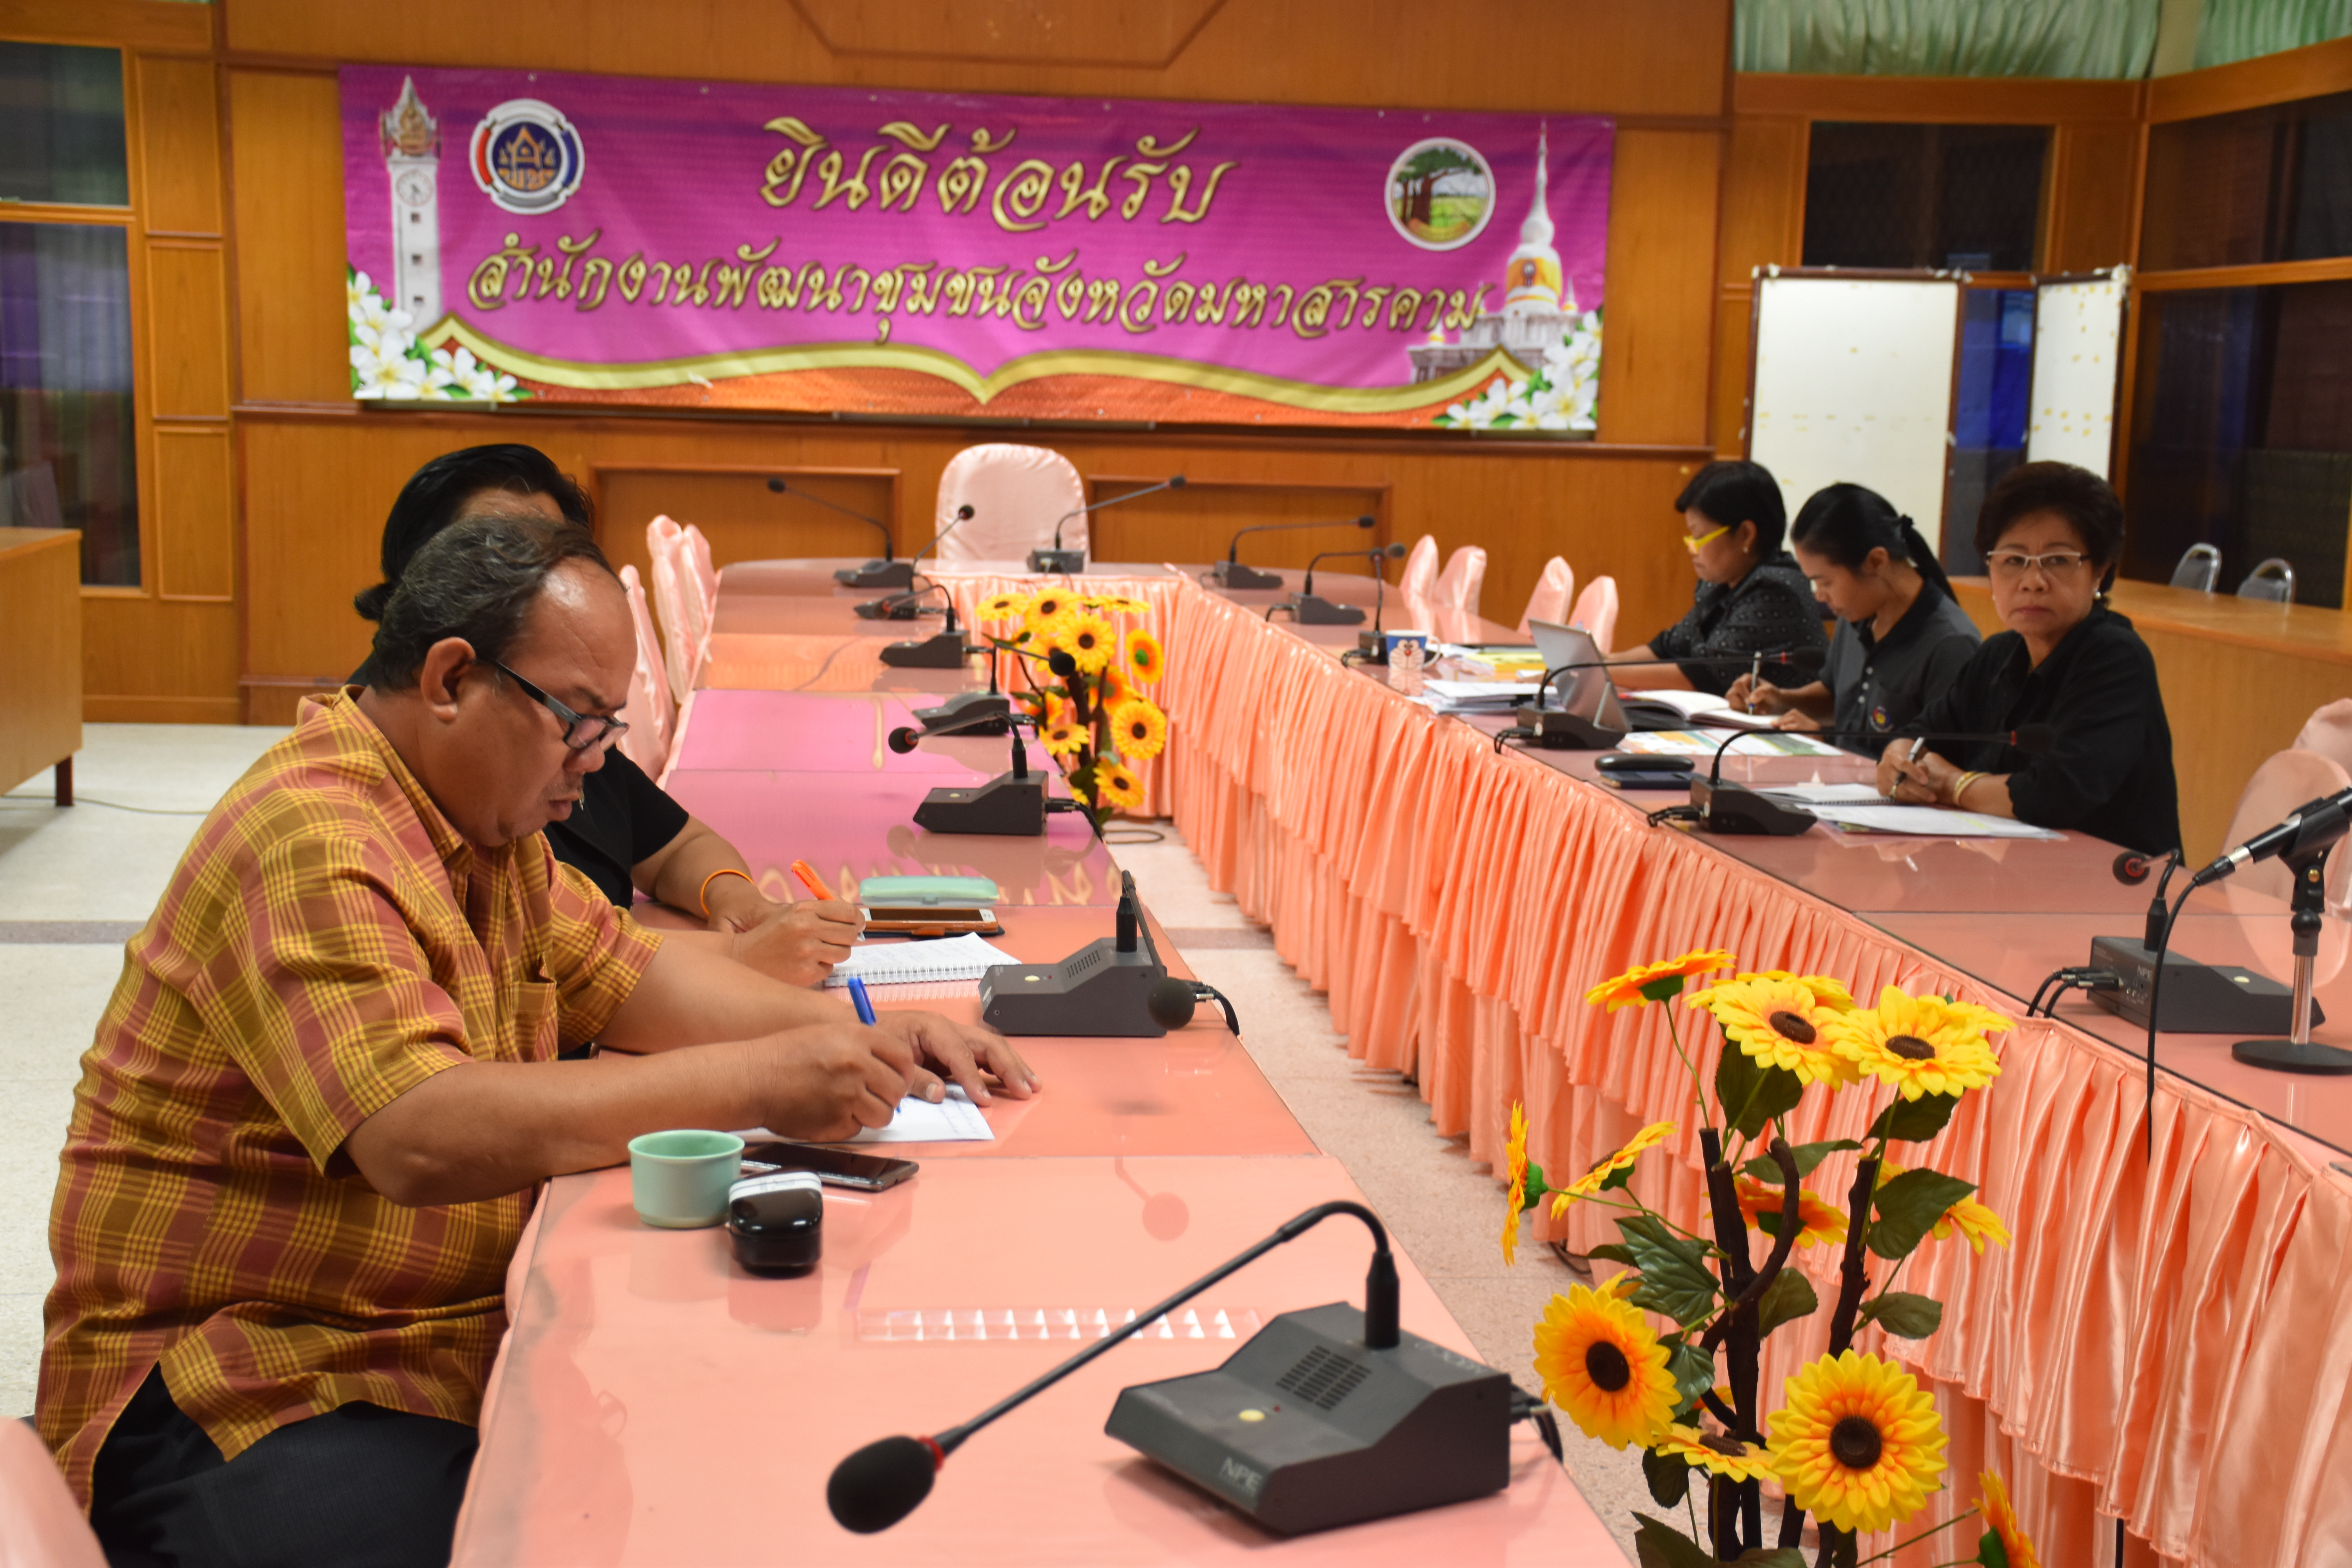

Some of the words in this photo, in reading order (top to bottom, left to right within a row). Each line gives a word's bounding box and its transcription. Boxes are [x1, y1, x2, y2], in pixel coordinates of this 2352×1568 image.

[760, 116, 1239, 231] ยินดีต้อนรับ
[1220, 1456, 1263, 1490] NPE
